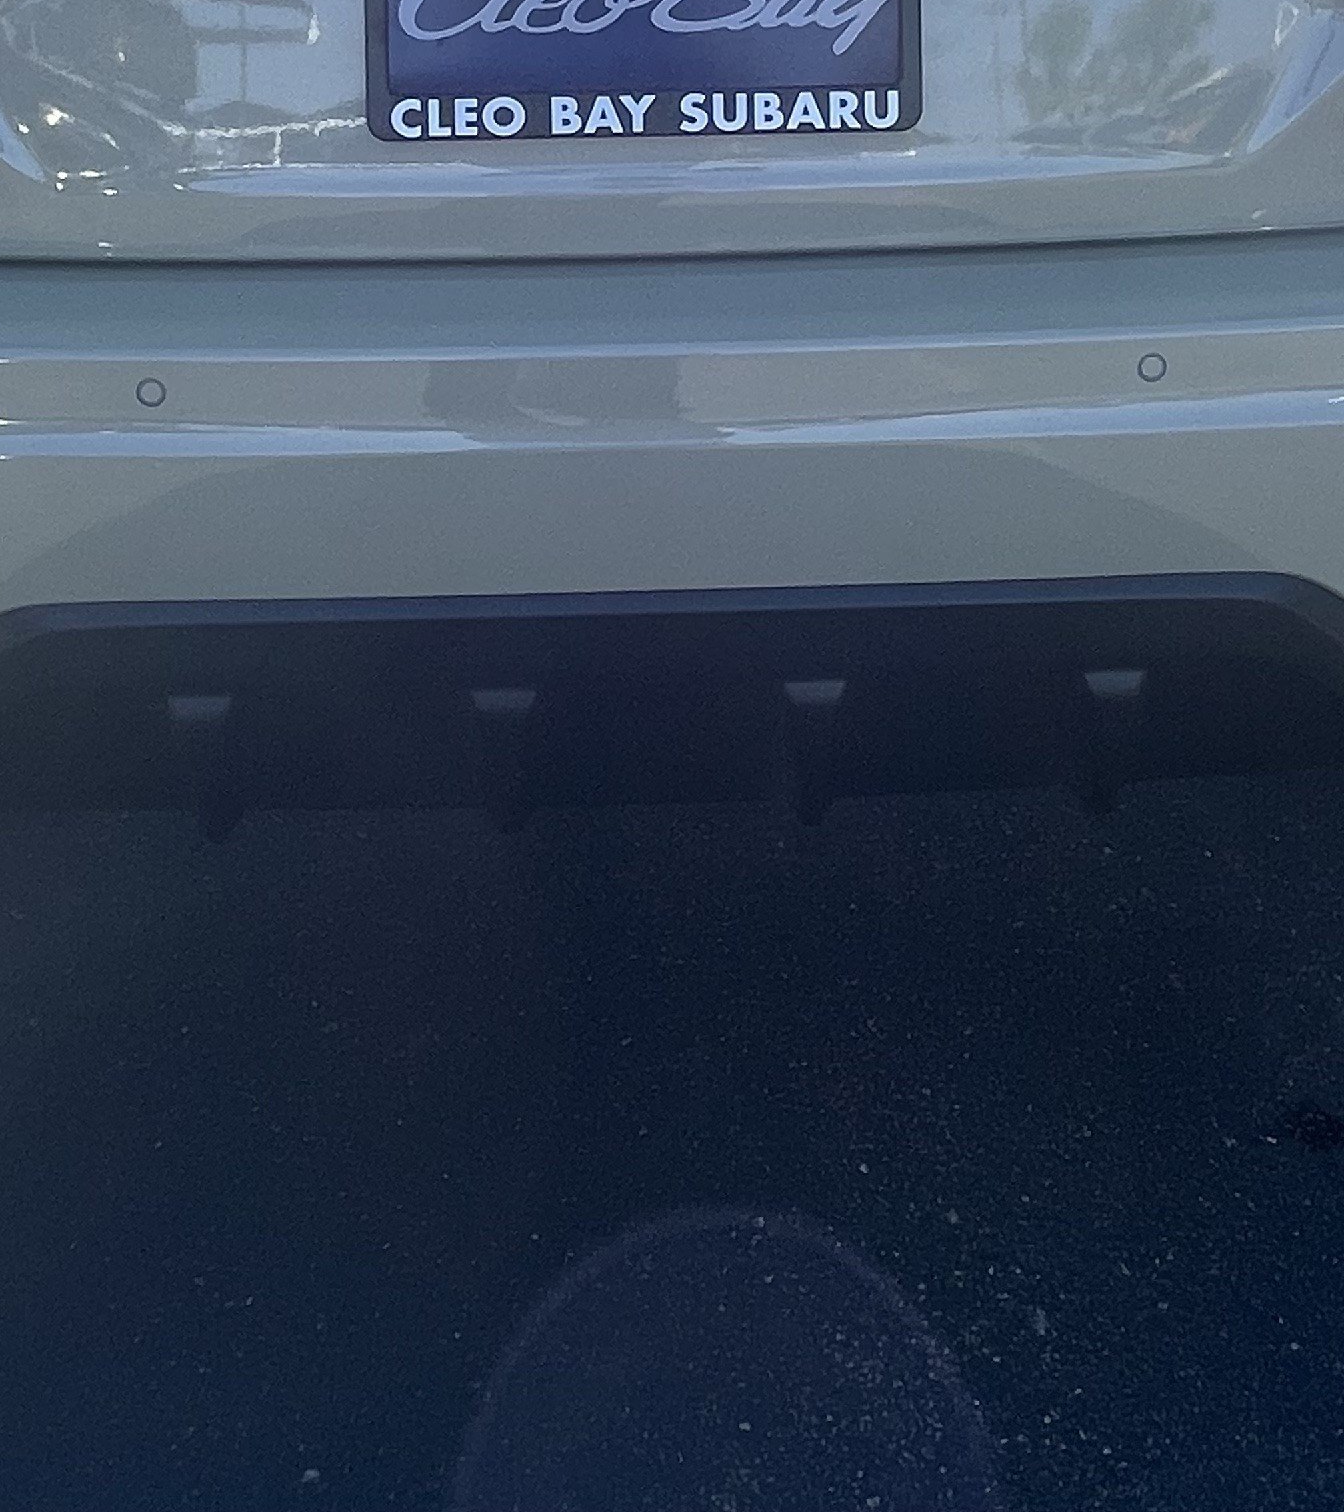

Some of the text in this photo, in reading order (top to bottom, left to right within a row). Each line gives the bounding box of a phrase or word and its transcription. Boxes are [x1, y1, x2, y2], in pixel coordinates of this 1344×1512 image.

[389, 90, 900, 138] CLEO BAY SUBARU
